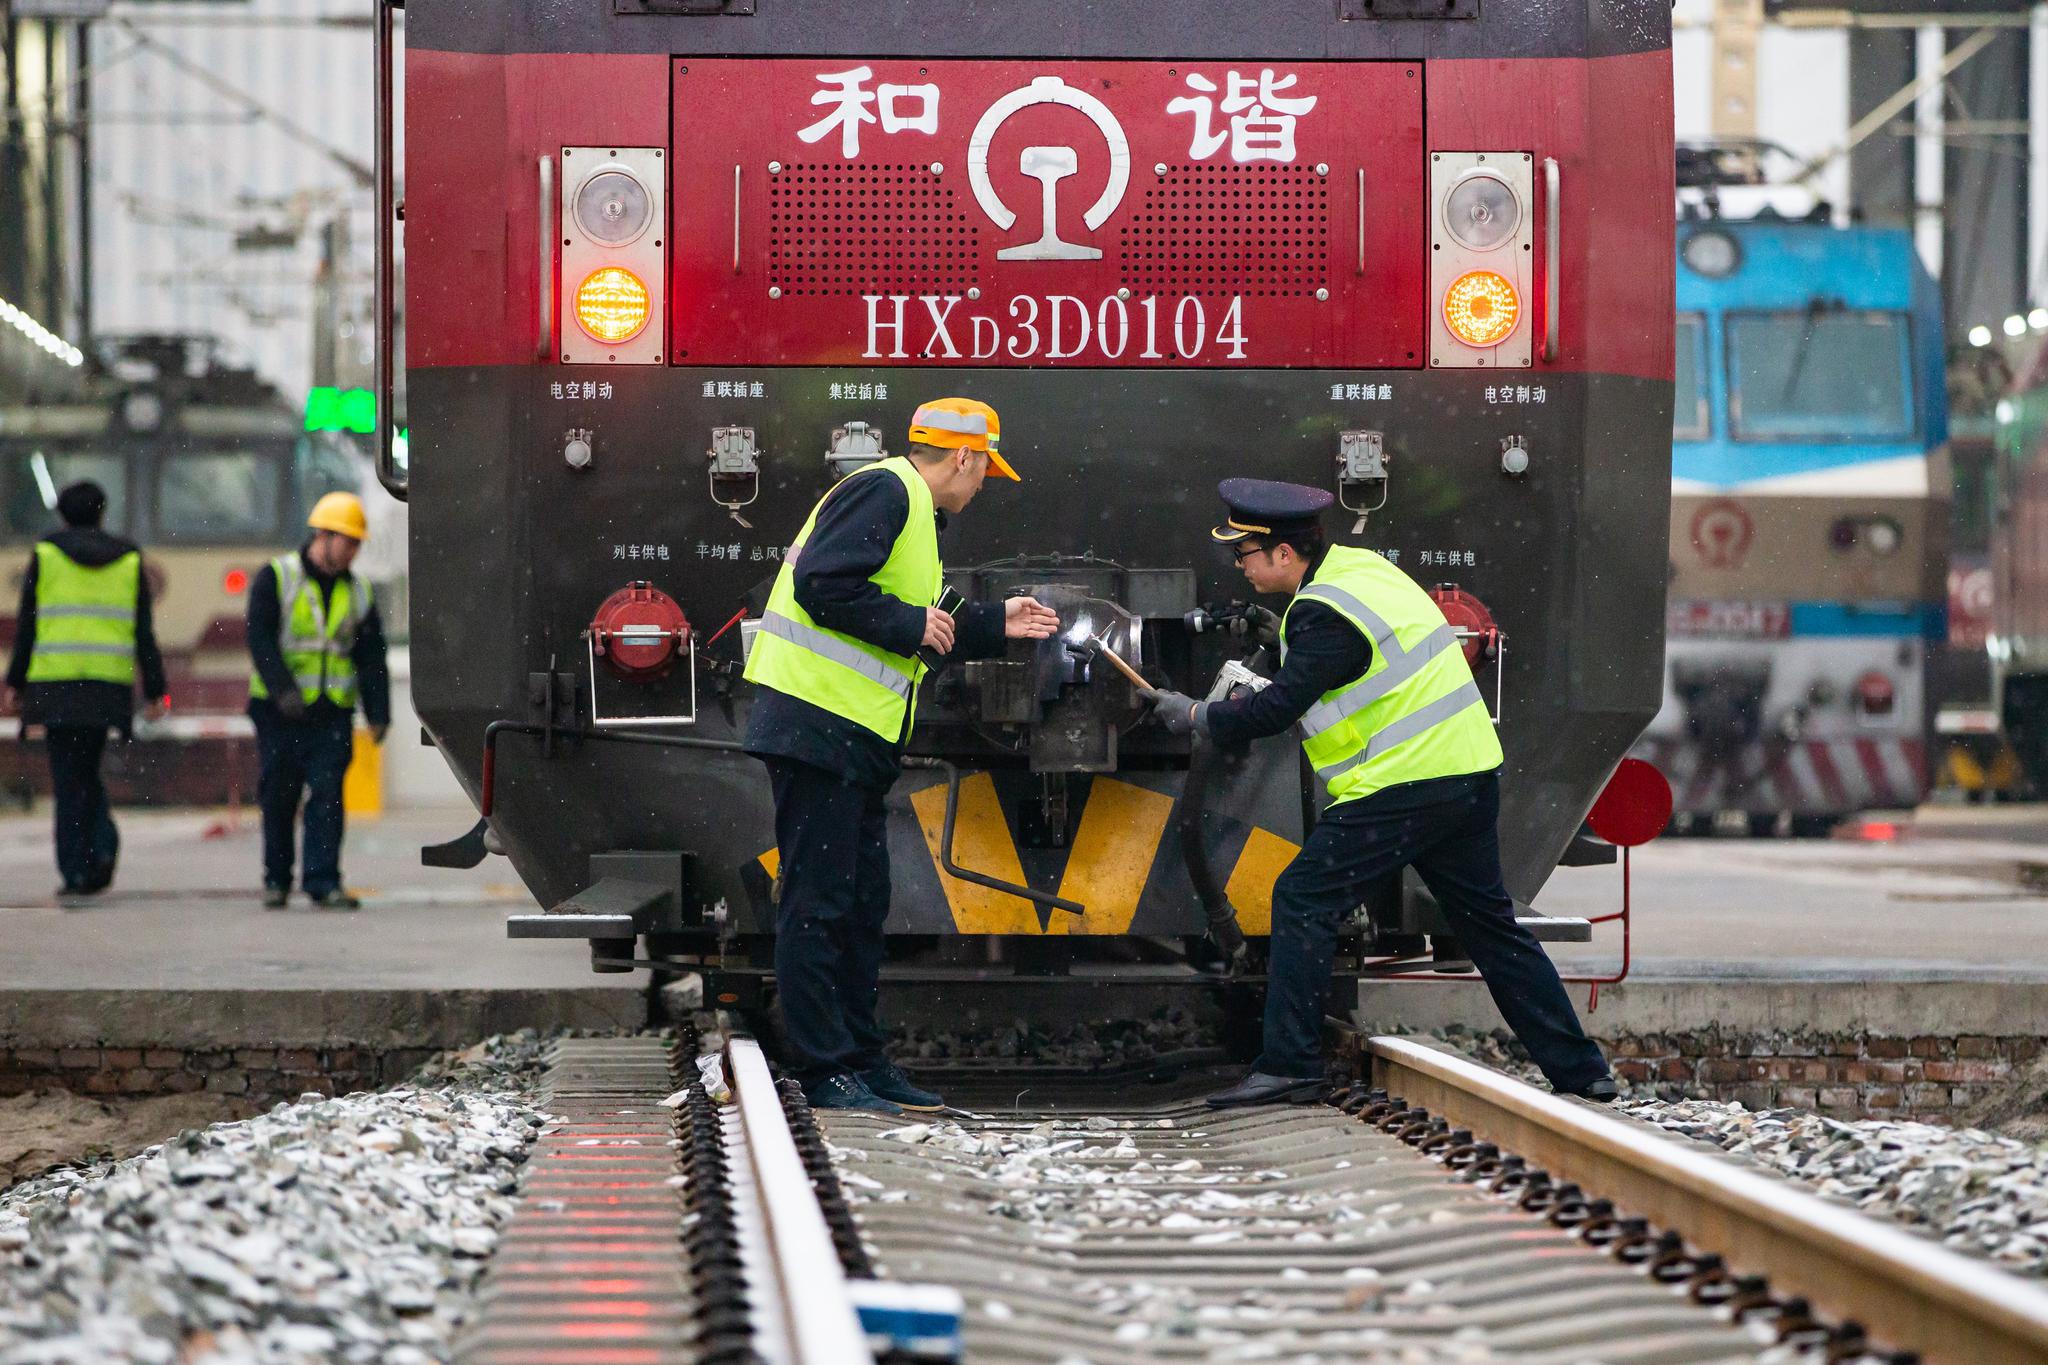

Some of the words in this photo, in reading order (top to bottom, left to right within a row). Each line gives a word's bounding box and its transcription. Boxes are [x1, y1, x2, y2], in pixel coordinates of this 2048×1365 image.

[796, 65, 942, 159] 和
[1165, 67, 1318, 163] 谐
[861, 294, 1250, 359] HXD3D0104
[550, 381, 613, 400] 电空制动
[701, 380, 764, 398] 重联插座
[828, 382, 888, 400] 集控插座
[1330, 383, 1393, 400] 重联插座
[1484, 385, 1546, 404] 电空制动
[612, 544, 670, 561] 列车供电
[696, 544, 741, 560] 平均管
[1419, 550, 1476, 567] 列车供电
